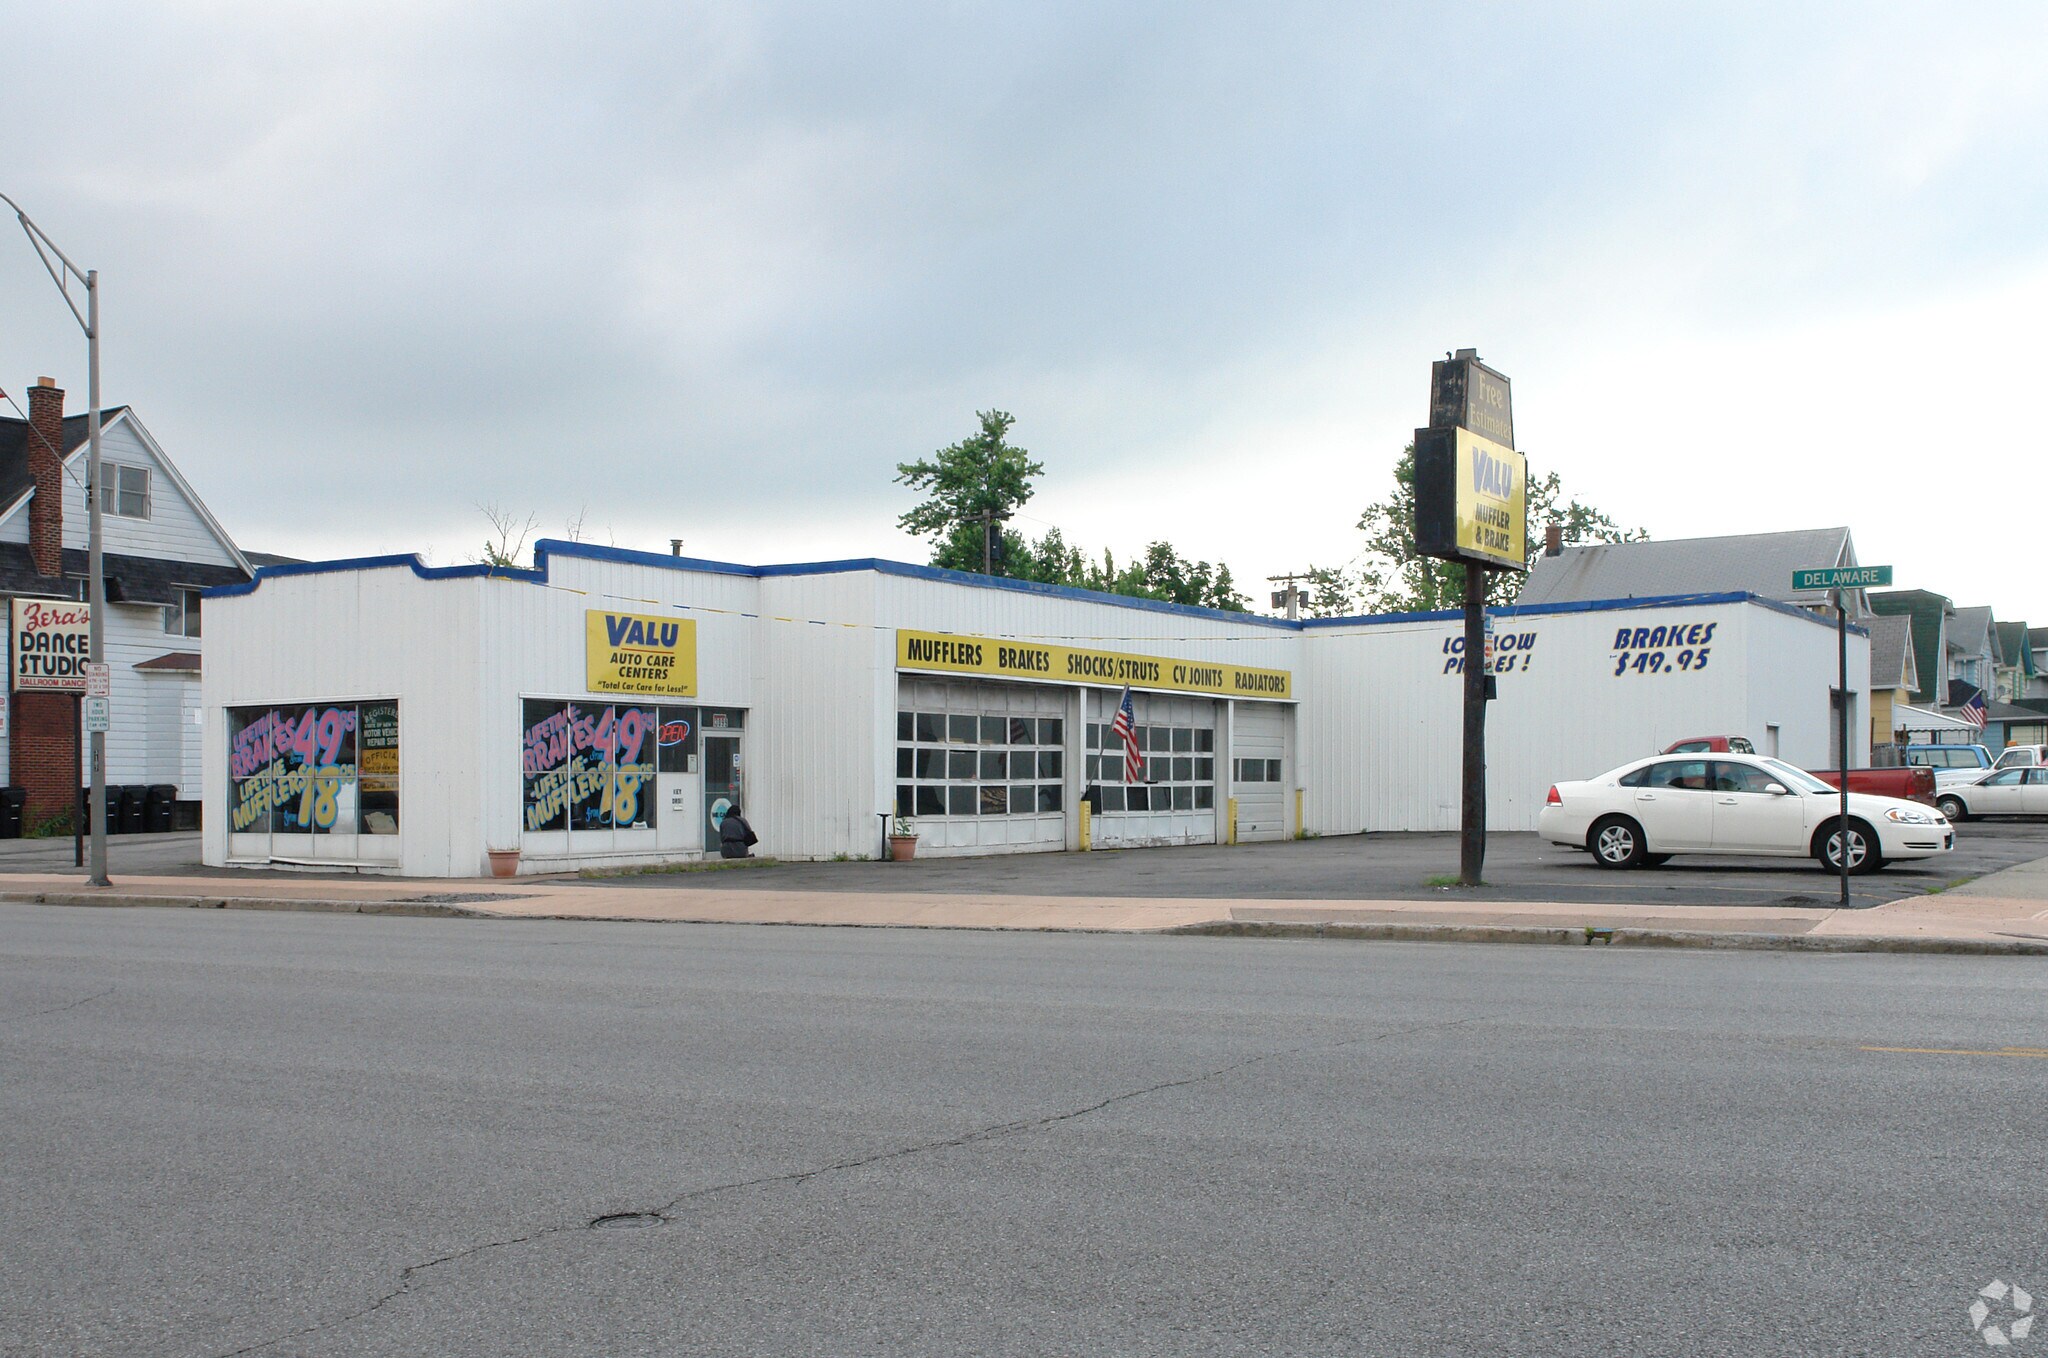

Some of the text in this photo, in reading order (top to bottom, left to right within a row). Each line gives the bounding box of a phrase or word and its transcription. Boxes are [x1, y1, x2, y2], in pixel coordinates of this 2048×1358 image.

[1472, 446, 1512, 499] VALU
[1475, 502, 1510, 531] MUFFLER
[1475, 525, 1509, 552] & BRAKE
[1804, 570, 1879, 586] DELAWARE
[23, 603, 90, 632] Zera's
[20, 631, 89, 654] DANCE
[605, 615, 679, 648] VALU
[1613, 622, 1718, 650] BRAKES
[1442, 636, 1465, 654] LO
[610, 652, 676, 668] AUTO CARE
[908, 638, 1286, 693] MUFFLERS BRAKES SHOCKS/STRUTS CV JOINTS RADIATORS
[1614, 649, 1711, 677] $49.95
[20, 677, 59, 686] BALLROOM
[619, 666, 669, 680] CENTERS
[622, 682, 634, 691] Car
[636, 684, 653, 692] Care
[654, 684, 665, 693] for
[363, 729, 382, 738] MOTOR
[367, 737, 398, 746] REPAIR SHO
[658, 724, 687, 742] OPEN
[231, 717, 295, 783] BRAKES
[365, 751, 398, 764] OFFICIA
[523, 715, 595, 779] BRAKES
